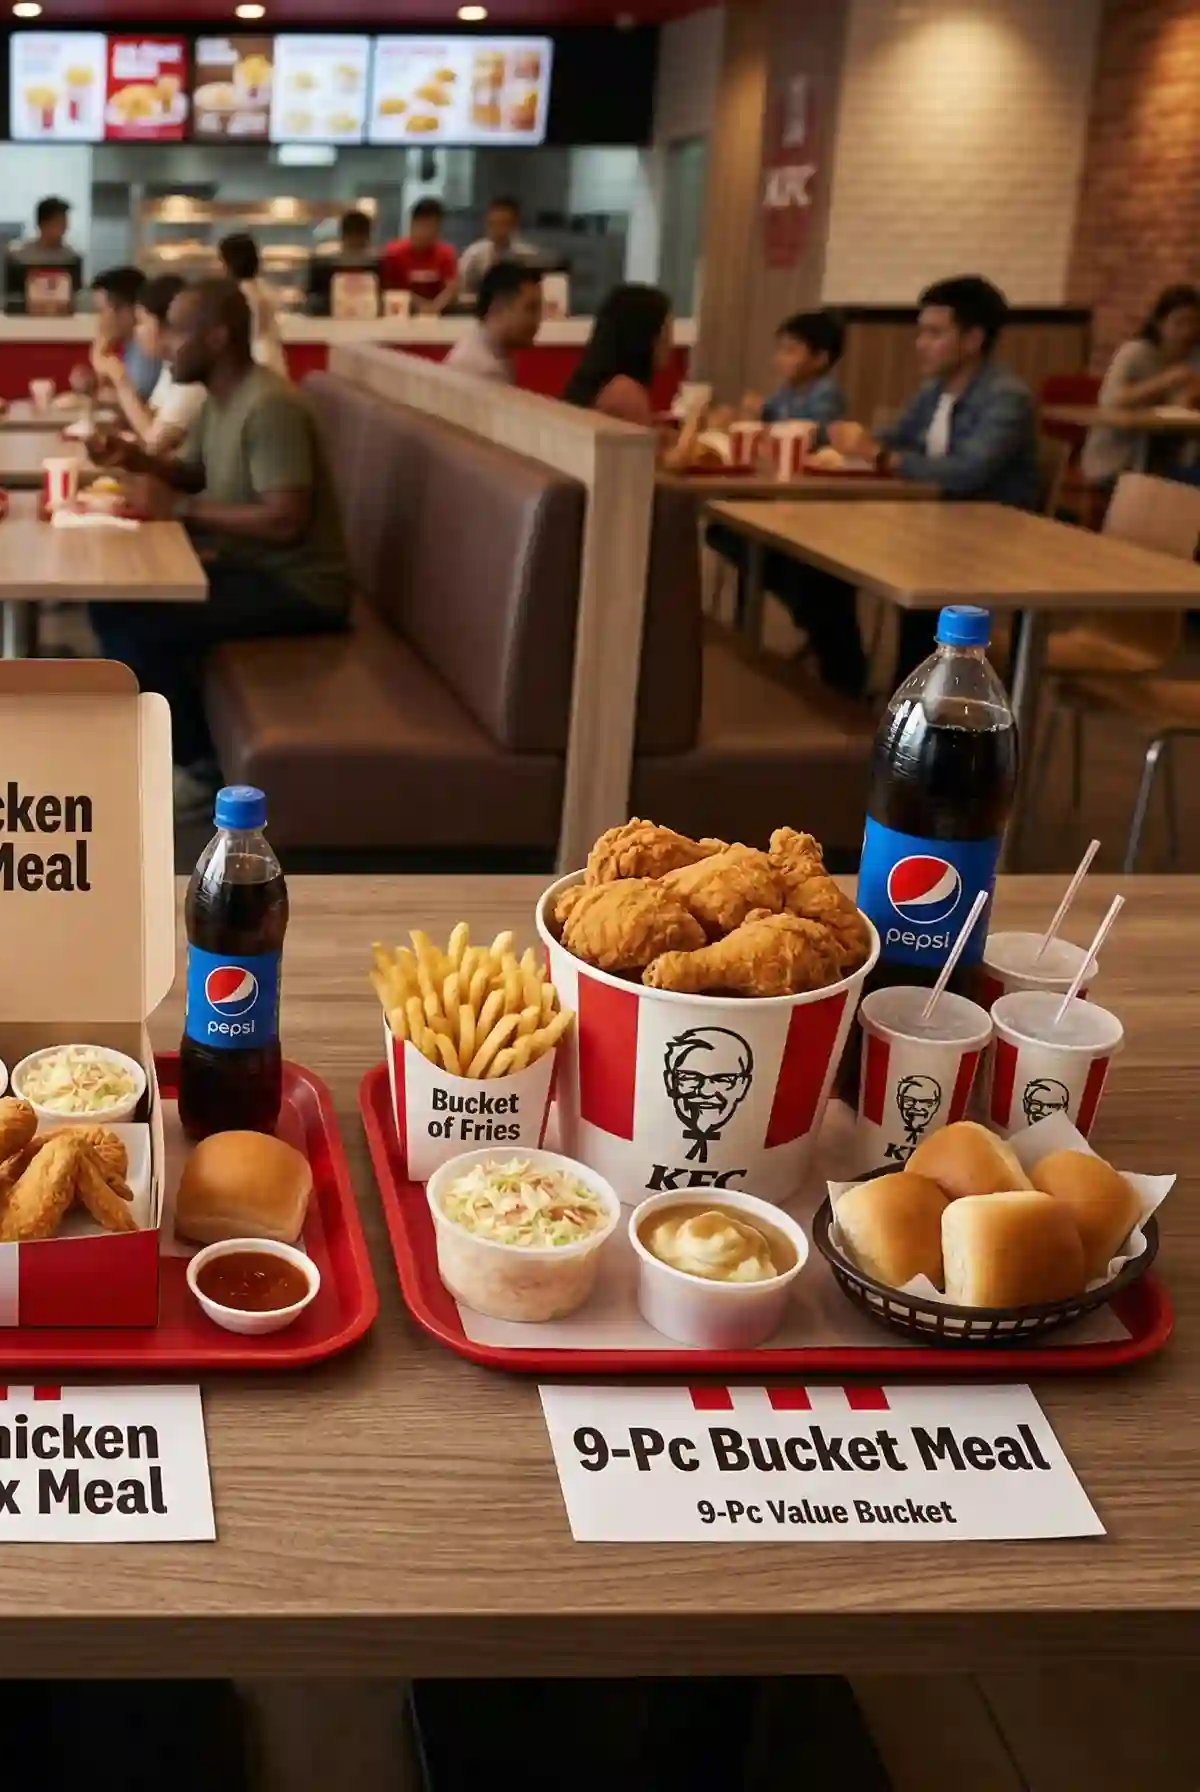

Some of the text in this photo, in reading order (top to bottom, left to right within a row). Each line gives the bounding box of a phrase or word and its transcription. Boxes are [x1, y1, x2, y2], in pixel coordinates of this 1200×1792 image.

[886, 928, 950, 952] pepsi
[432, 1087, 519, 1114] Bucket
[428, 1116, 520, 1140] of Fries
[573, 1423, 1051, 1472] 9-Pc Bucket Meal
[38, 1466, 167, 1514] Meal
[697, 1499, 957, 1524] 9-Pc Value Bucket
